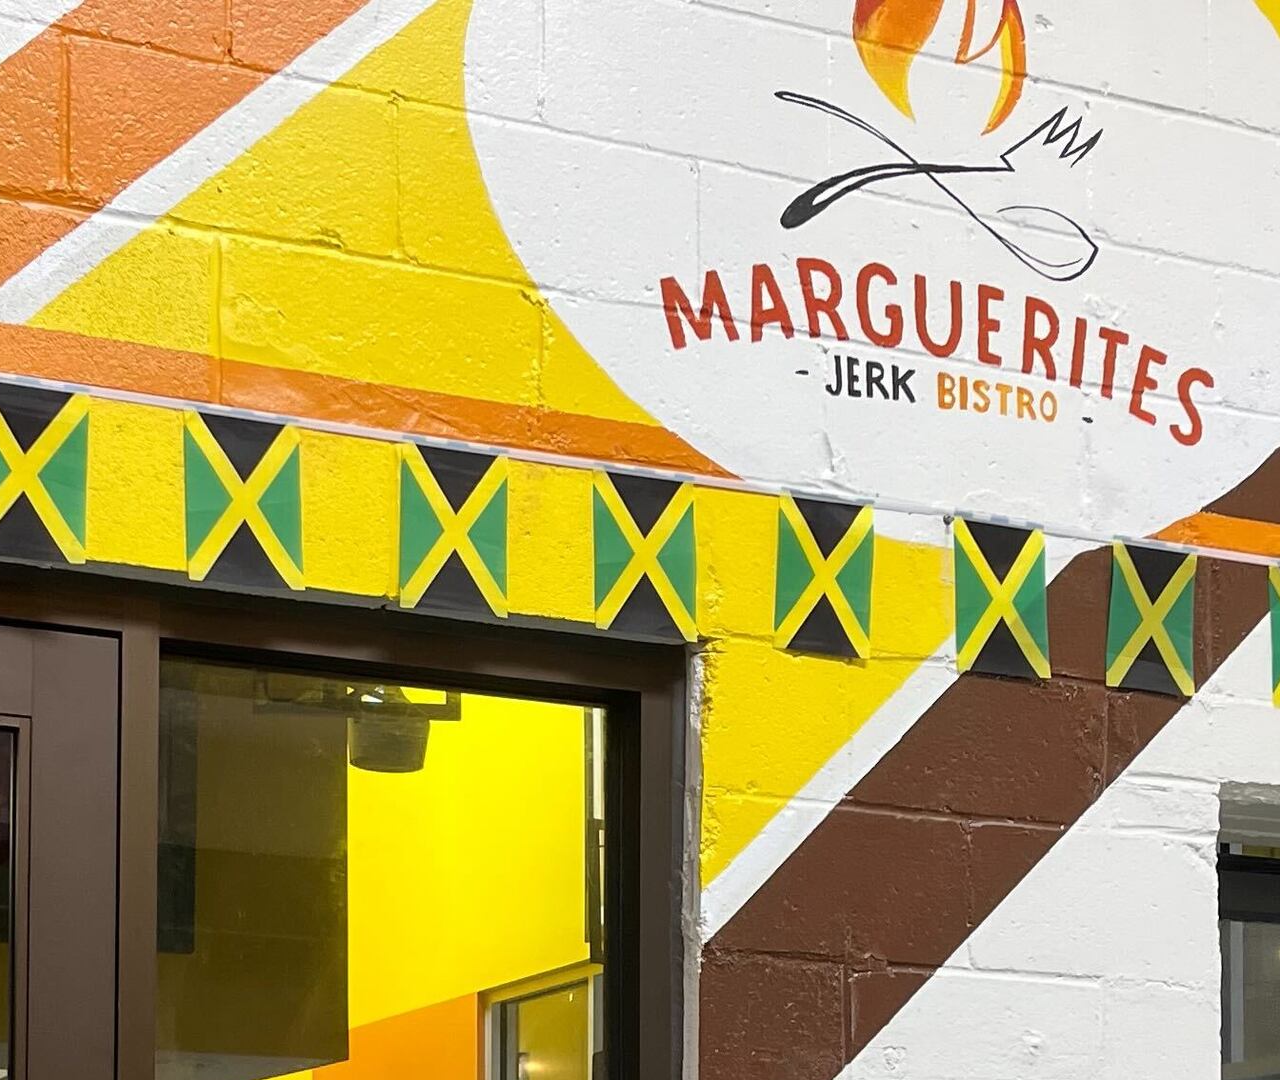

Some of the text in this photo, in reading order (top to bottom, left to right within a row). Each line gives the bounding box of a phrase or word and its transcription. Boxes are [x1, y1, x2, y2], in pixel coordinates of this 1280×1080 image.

[659, 257, 1216, 447] MARGUERITES
[825, 354, 1059, 424] JERK BISTRO
